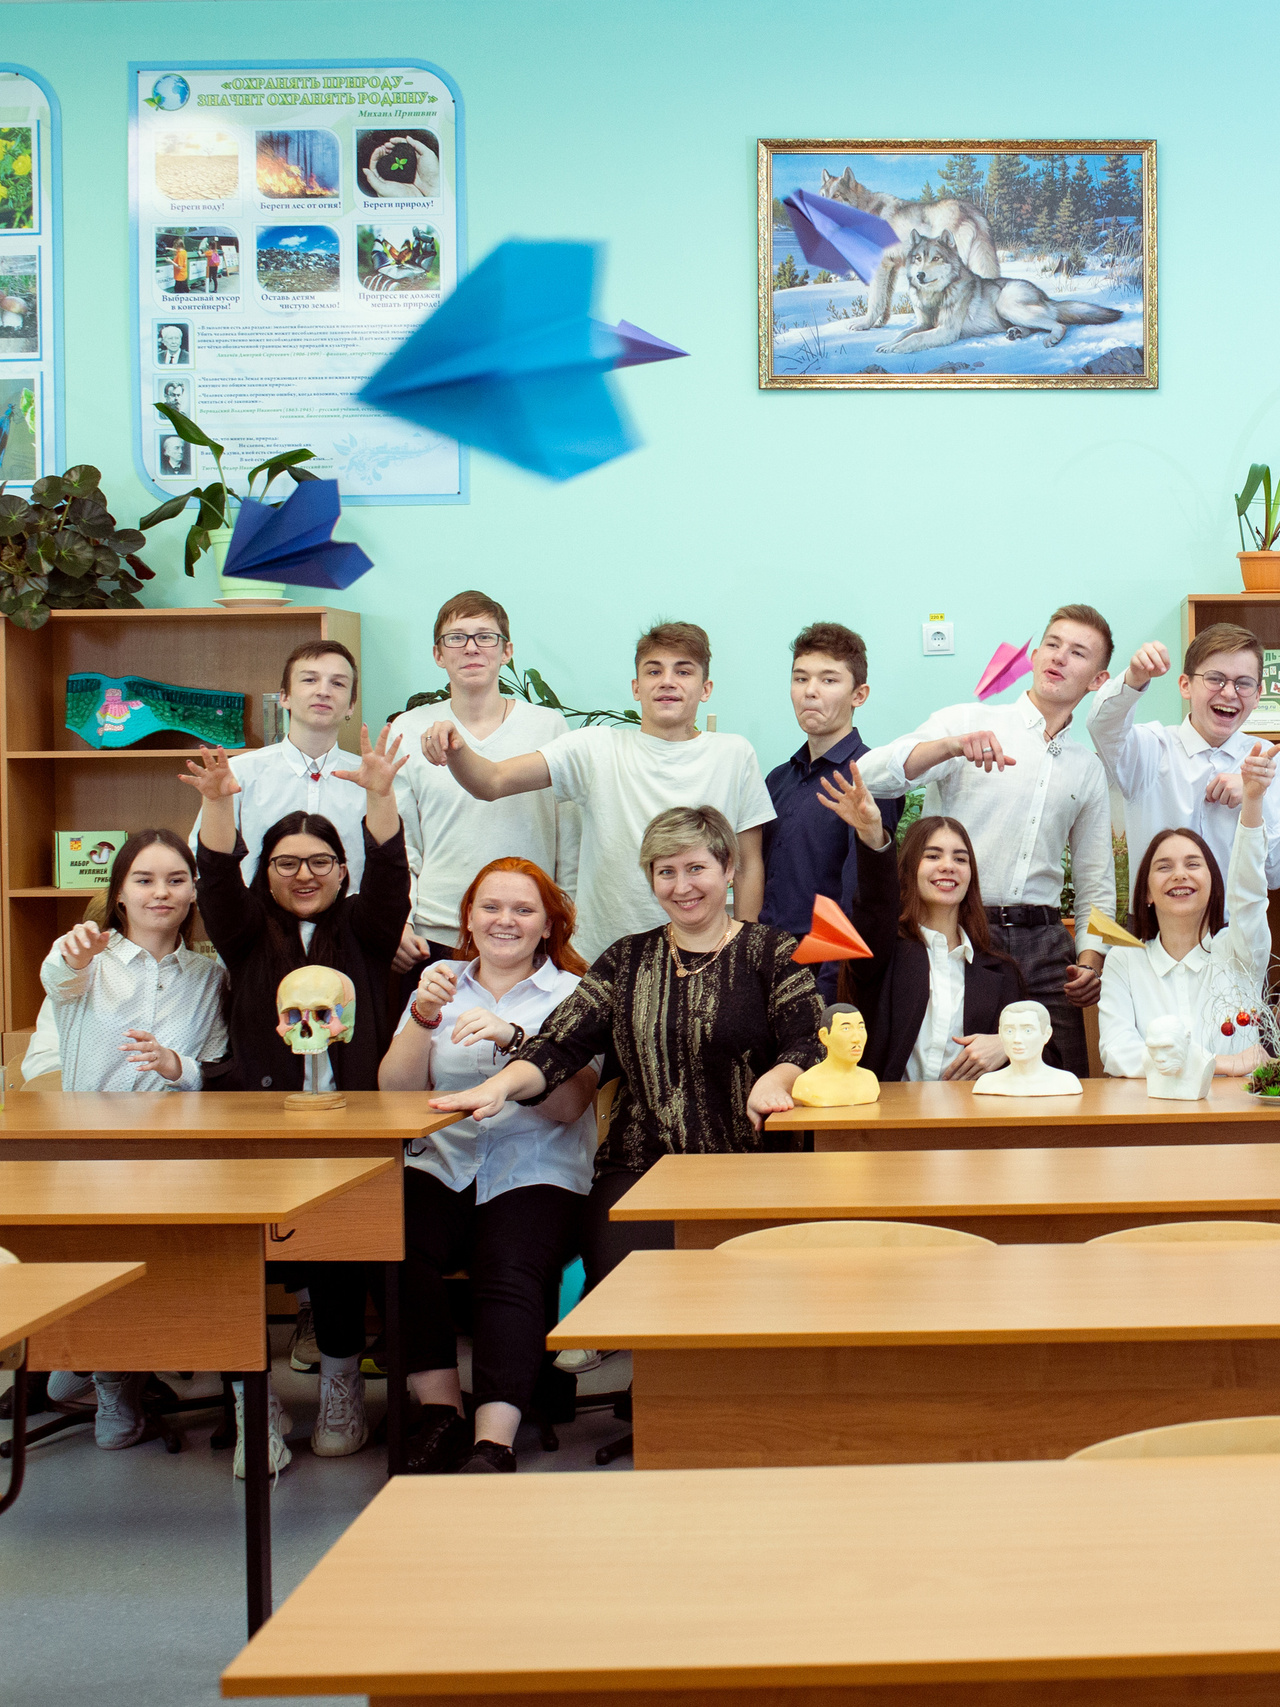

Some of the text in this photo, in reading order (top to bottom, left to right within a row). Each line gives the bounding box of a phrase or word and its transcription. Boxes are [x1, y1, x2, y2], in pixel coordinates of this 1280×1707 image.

[220, 76, 321, 91] «ОХРАНЯТЬ
[322, 75, 404, 91] ПРИРОДУ
[197, 91, 439, 107] ЗНАЧИТ ОХРАНЯТЬ РОДИНУ»
[358, 109, 438, 119] Михаил Пришвин
[170, 203, 225, 212] Береги воду!
[260, 202, 290, 211] Береги
[363, 200, 434, 210] Береги природу!
[162, 294, 240, 305] Выбрасывай мусор
[261, 293, 290, 301] Оставь
[358, 292, 397, 301] Прогресс
[177, 303, 231, 312] контейнеры!
[79, 867, 108, 875] МУЛЯЖЕЙ
